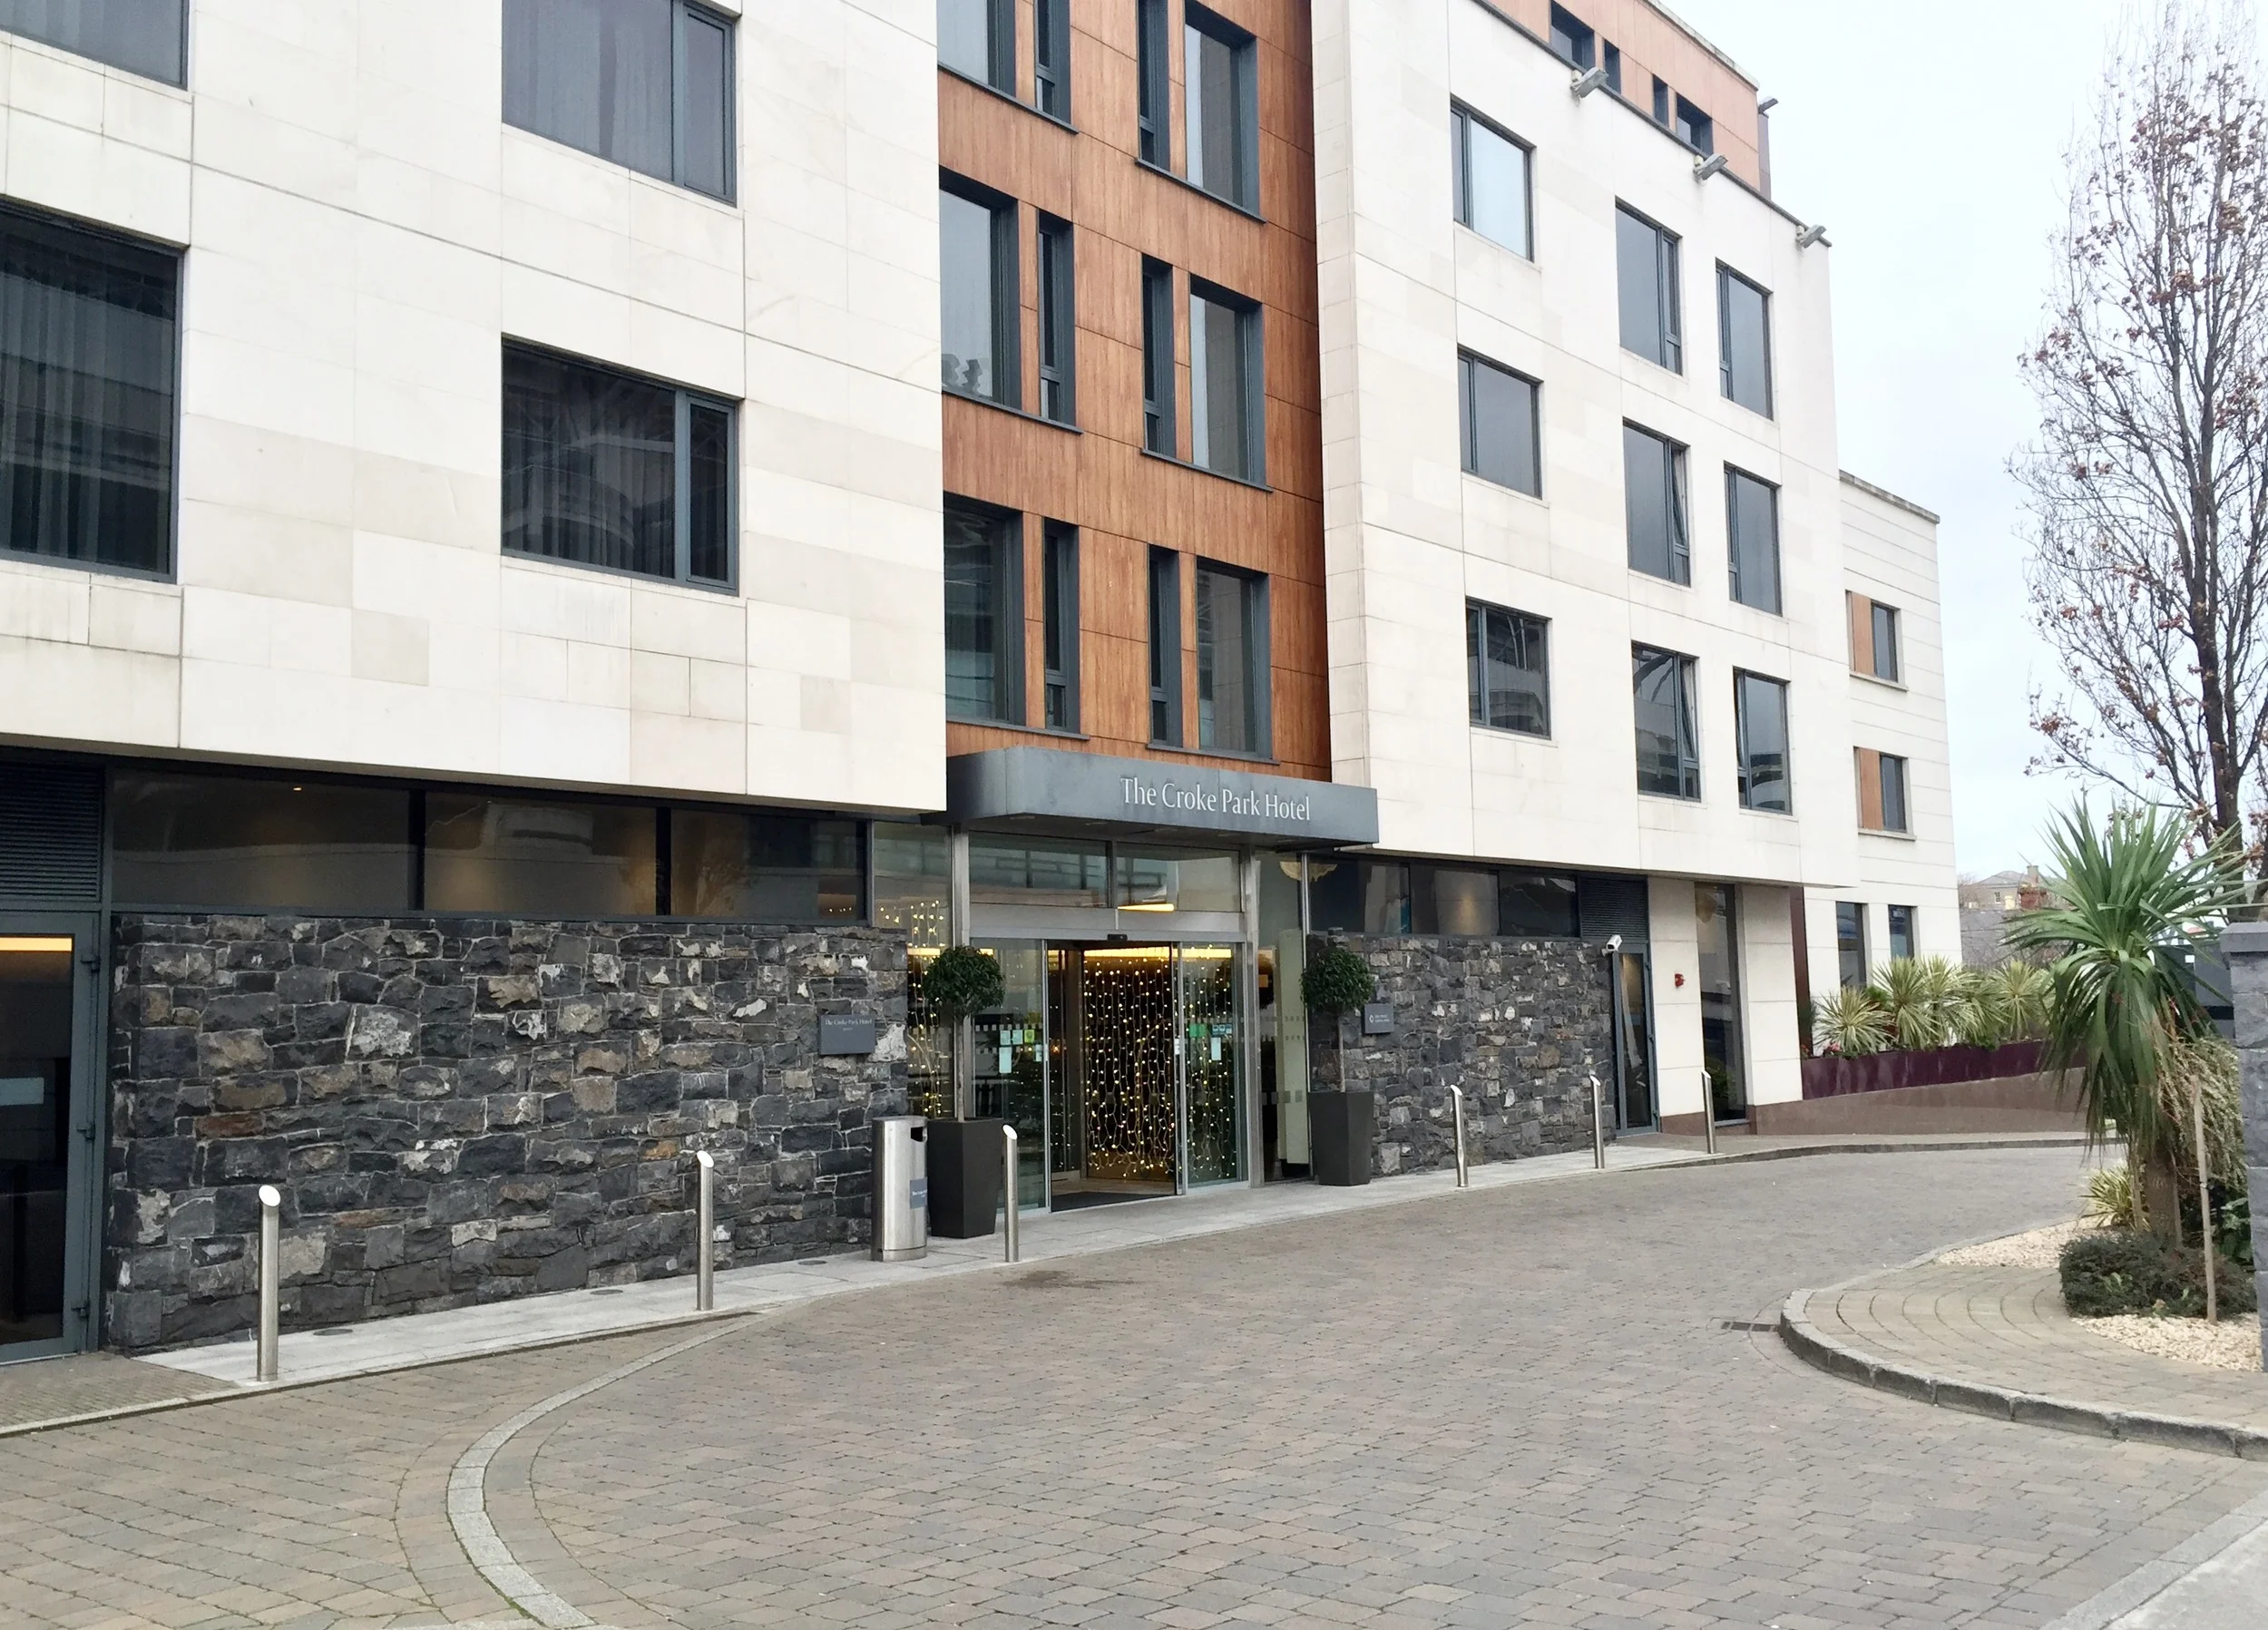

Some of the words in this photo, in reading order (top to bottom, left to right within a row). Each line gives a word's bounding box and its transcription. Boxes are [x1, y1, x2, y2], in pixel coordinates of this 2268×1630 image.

[1120, 777, 1157, 806] The
[1162, 783, 1217, 812] Croke
[1222, 789, 1260, 815] Park
[1266, 794, 1310, 821] Hotel
